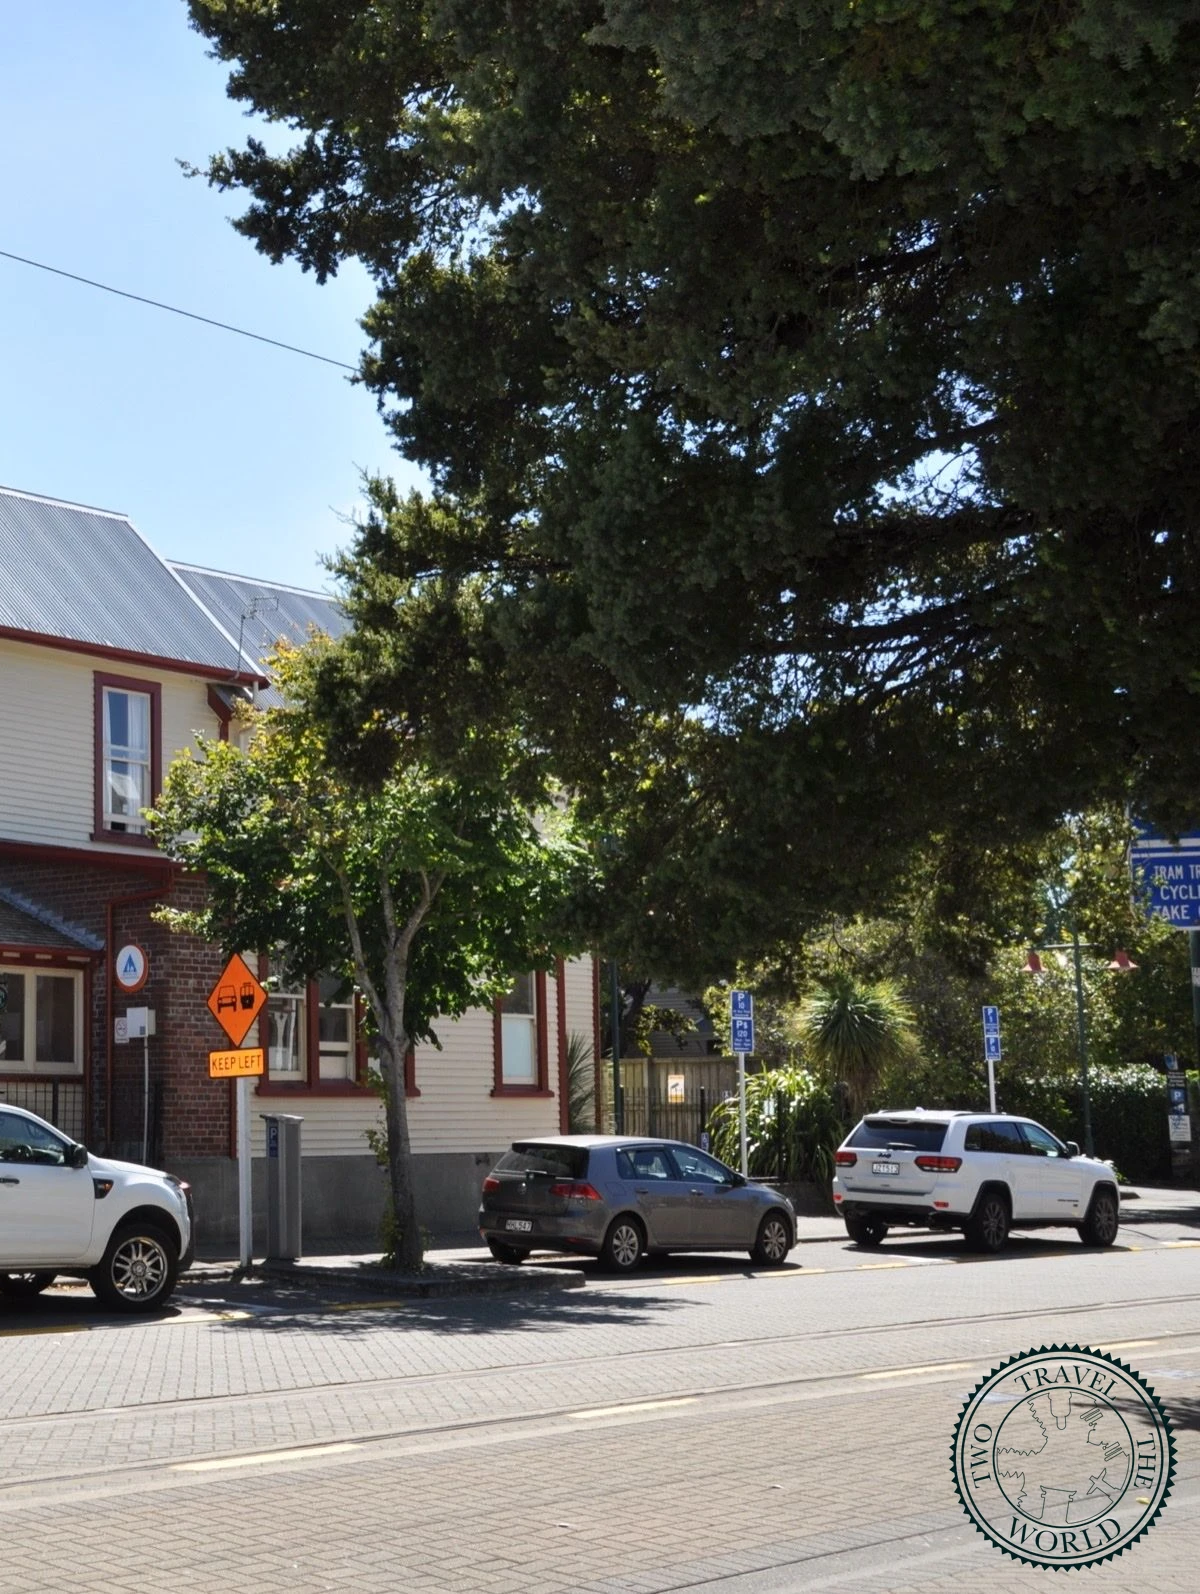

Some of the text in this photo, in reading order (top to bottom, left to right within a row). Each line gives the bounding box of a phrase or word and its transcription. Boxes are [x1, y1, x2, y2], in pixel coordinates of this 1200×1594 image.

[1154, 865, 1183, 880] TRAM
[212, 1054, 262, 1071] KEEP LEFT
[270, 1127, 278, 1139] P
